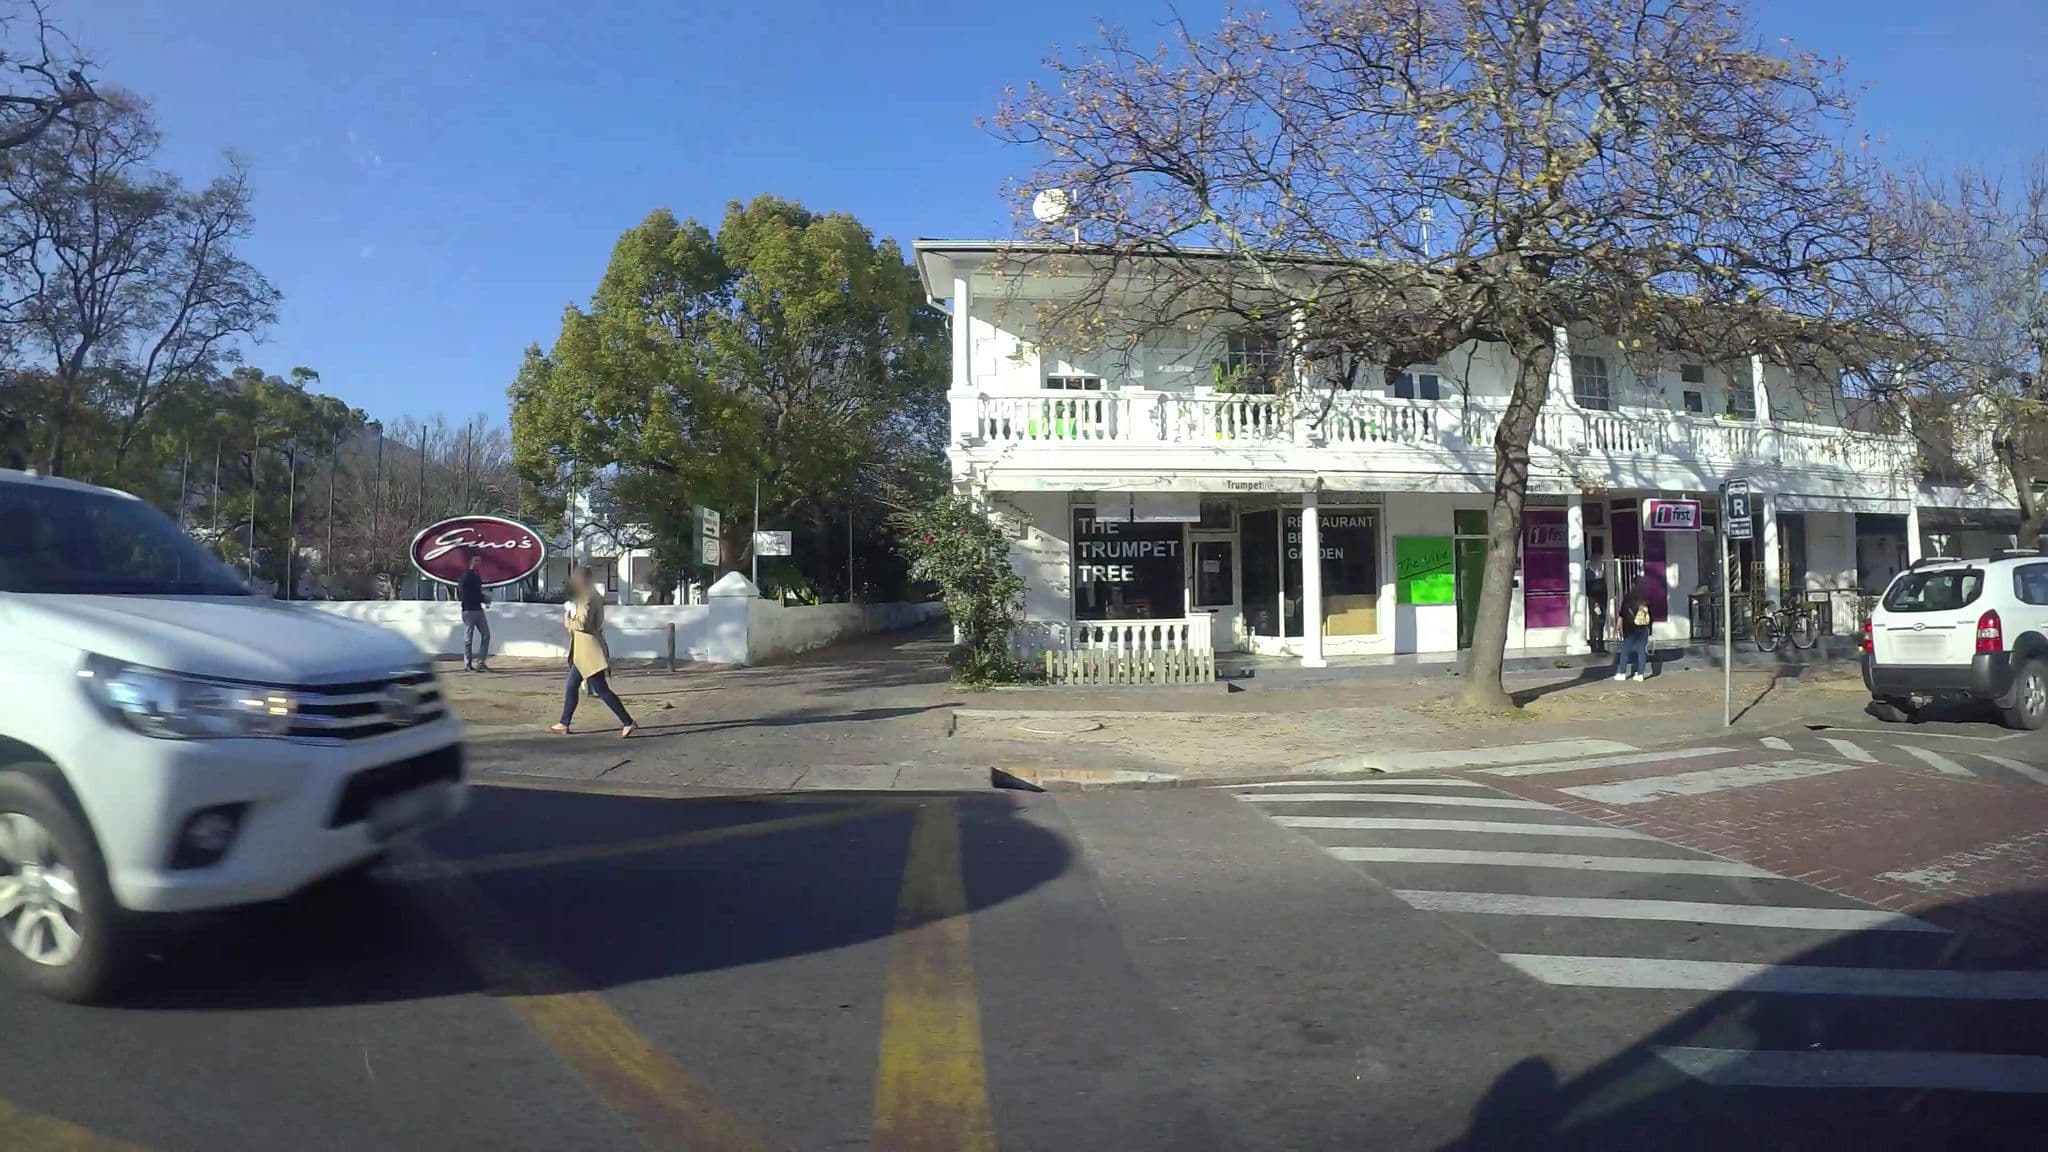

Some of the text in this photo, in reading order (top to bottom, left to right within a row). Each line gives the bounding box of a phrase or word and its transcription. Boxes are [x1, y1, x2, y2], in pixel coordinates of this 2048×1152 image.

[1733, 498, 1745, 516] R
[1079, 517, 1119, 534] THE
[423, 527, 532, 561] Gino's
[1079, 541, 1178, 558] TRUMPET
[1079, 565, 1135, 582] TREE
